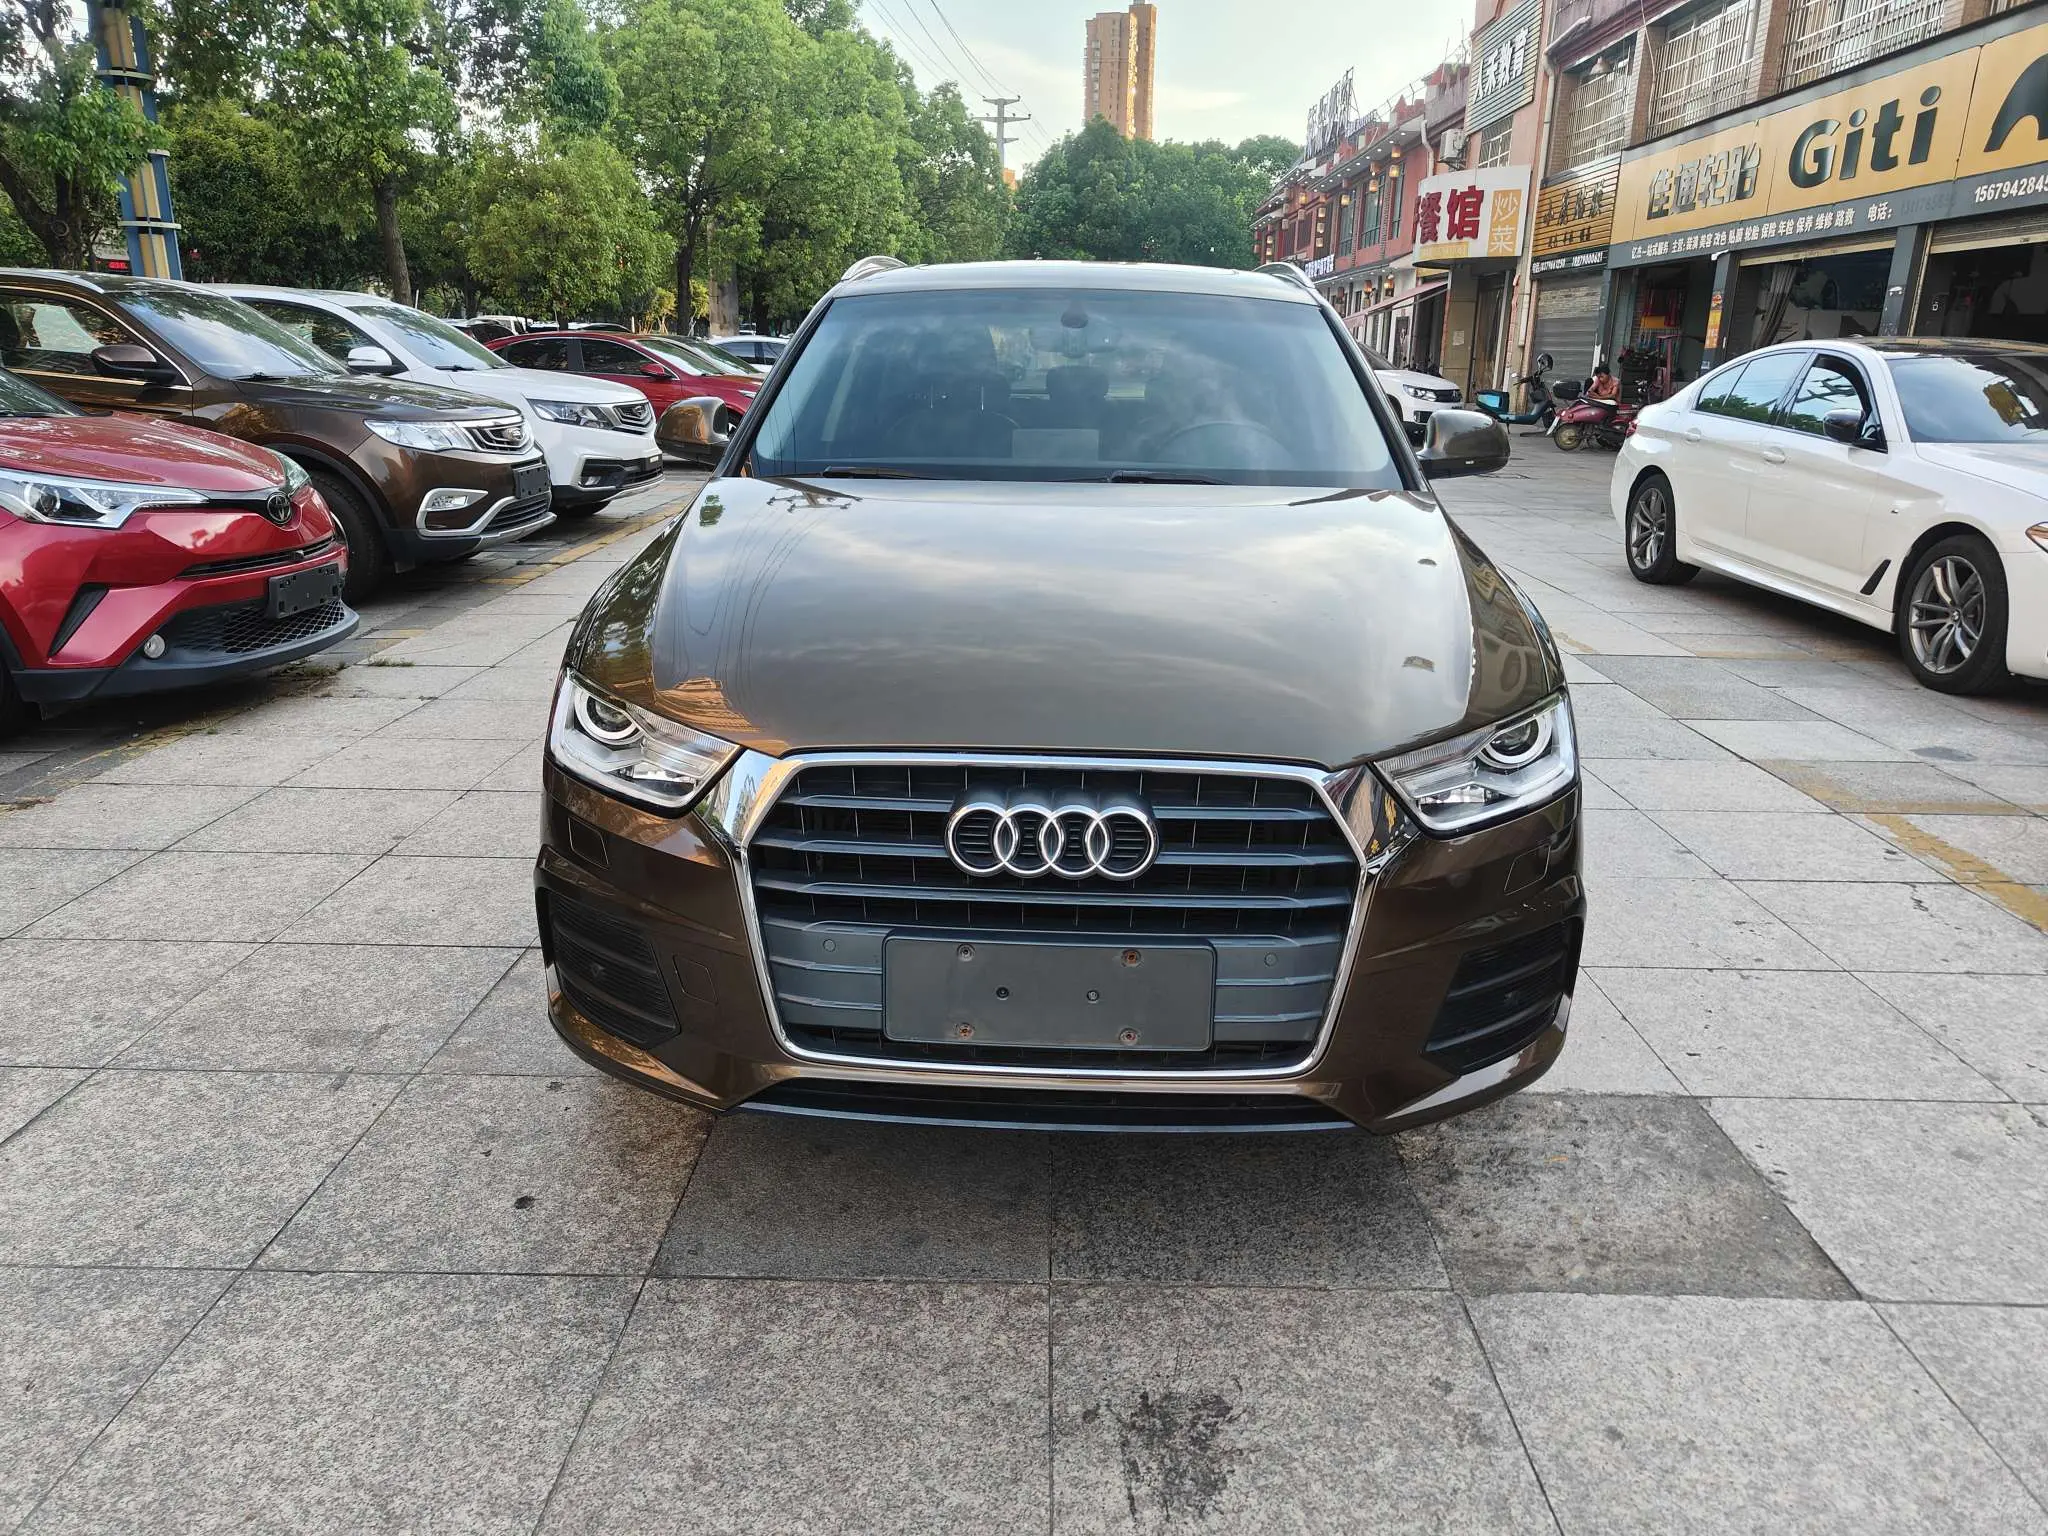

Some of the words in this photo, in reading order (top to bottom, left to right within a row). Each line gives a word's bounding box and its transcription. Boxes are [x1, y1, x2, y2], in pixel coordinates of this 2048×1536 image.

[1646, 141, 1761, 220] 佳通轮胎
[1788, 85, 1942, 189] Giti
[1490, 192, 1520, 253] 炒菜
[1700, 232, 1713, 248] 美容
[1745, 224, 1760, 242] 轮胎
[1761, 221, 1777, 239] 保险
[1778, 218, 1794, 236] 年检
[1796, 214, 1814, 233] 保养
[1815, 211, 1834, 230] 维修
